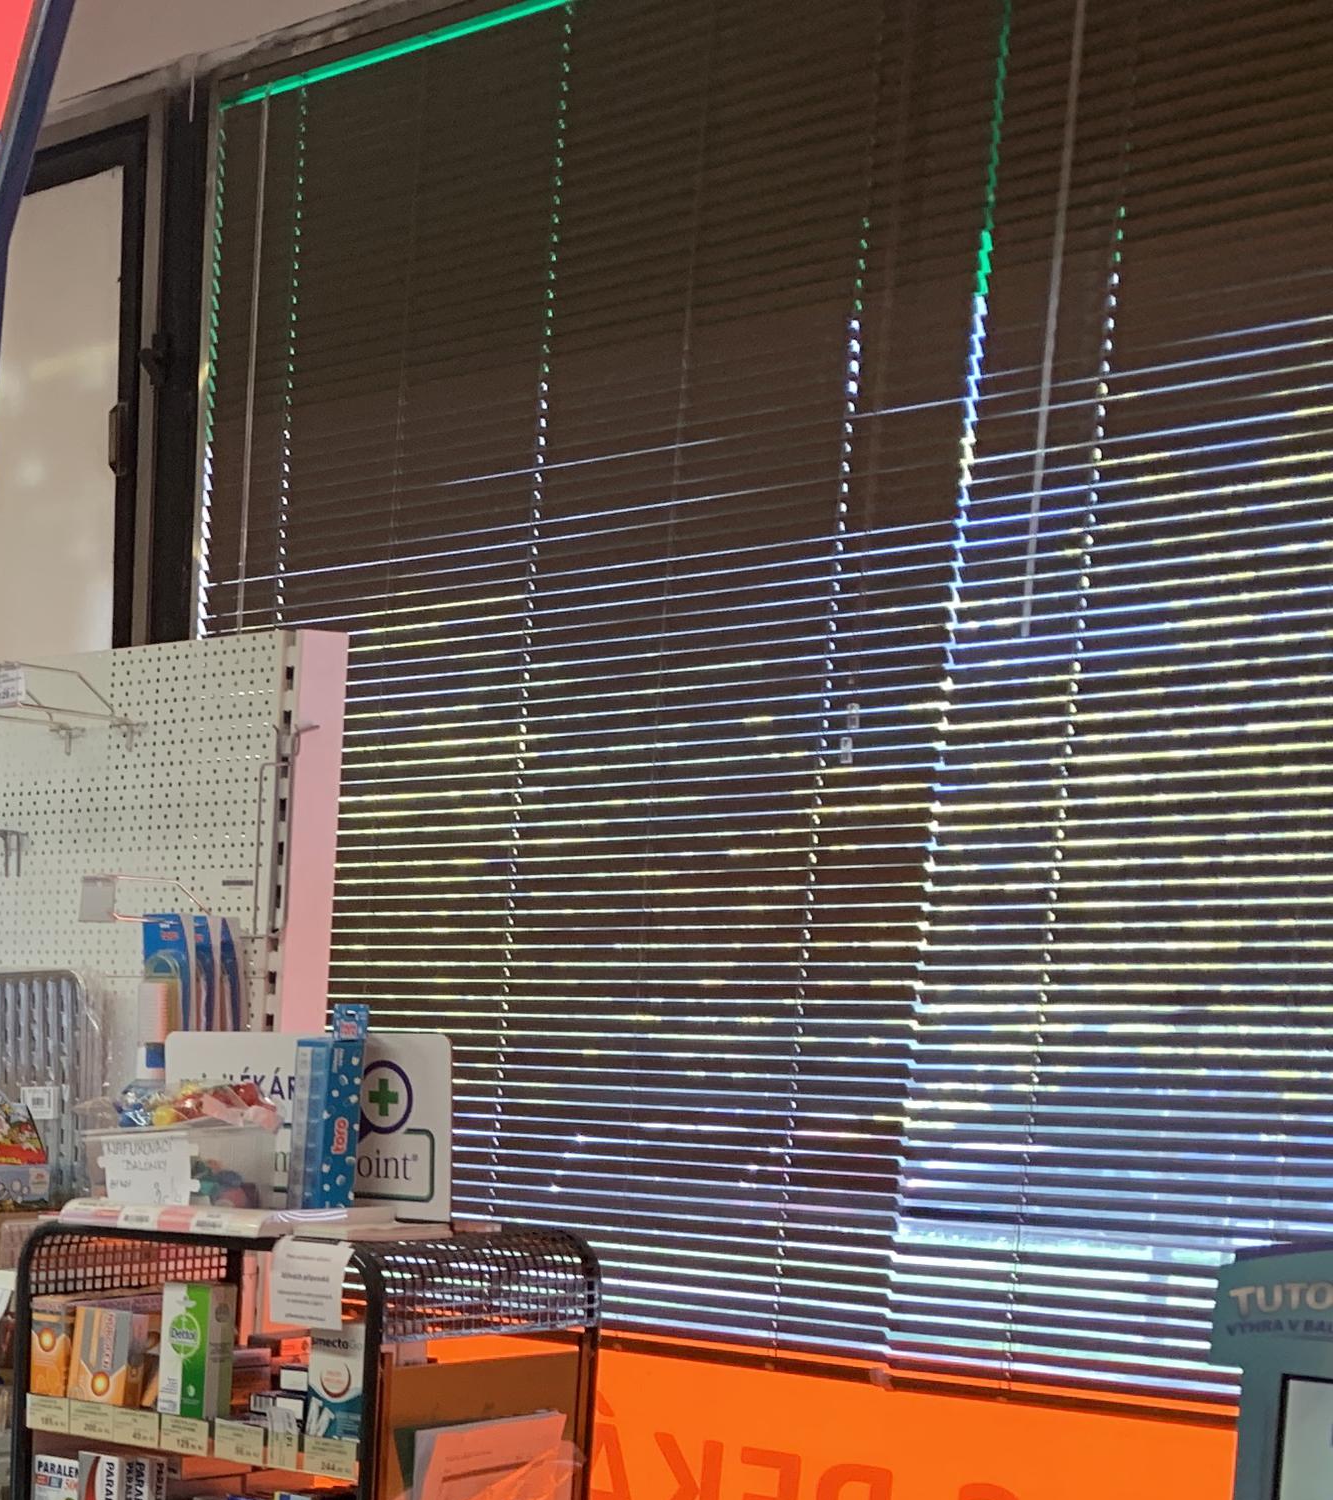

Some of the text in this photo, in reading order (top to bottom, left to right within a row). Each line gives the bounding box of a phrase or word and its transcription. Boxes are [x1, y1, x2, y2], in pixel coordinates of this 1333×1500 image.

[333, 1117, 348, 1153] toro
[1288, 1317, 1302, 1332] V
[168, 1328, 197, 1342] Dettol
[37, 1461, 79, 1477] PARALEN
